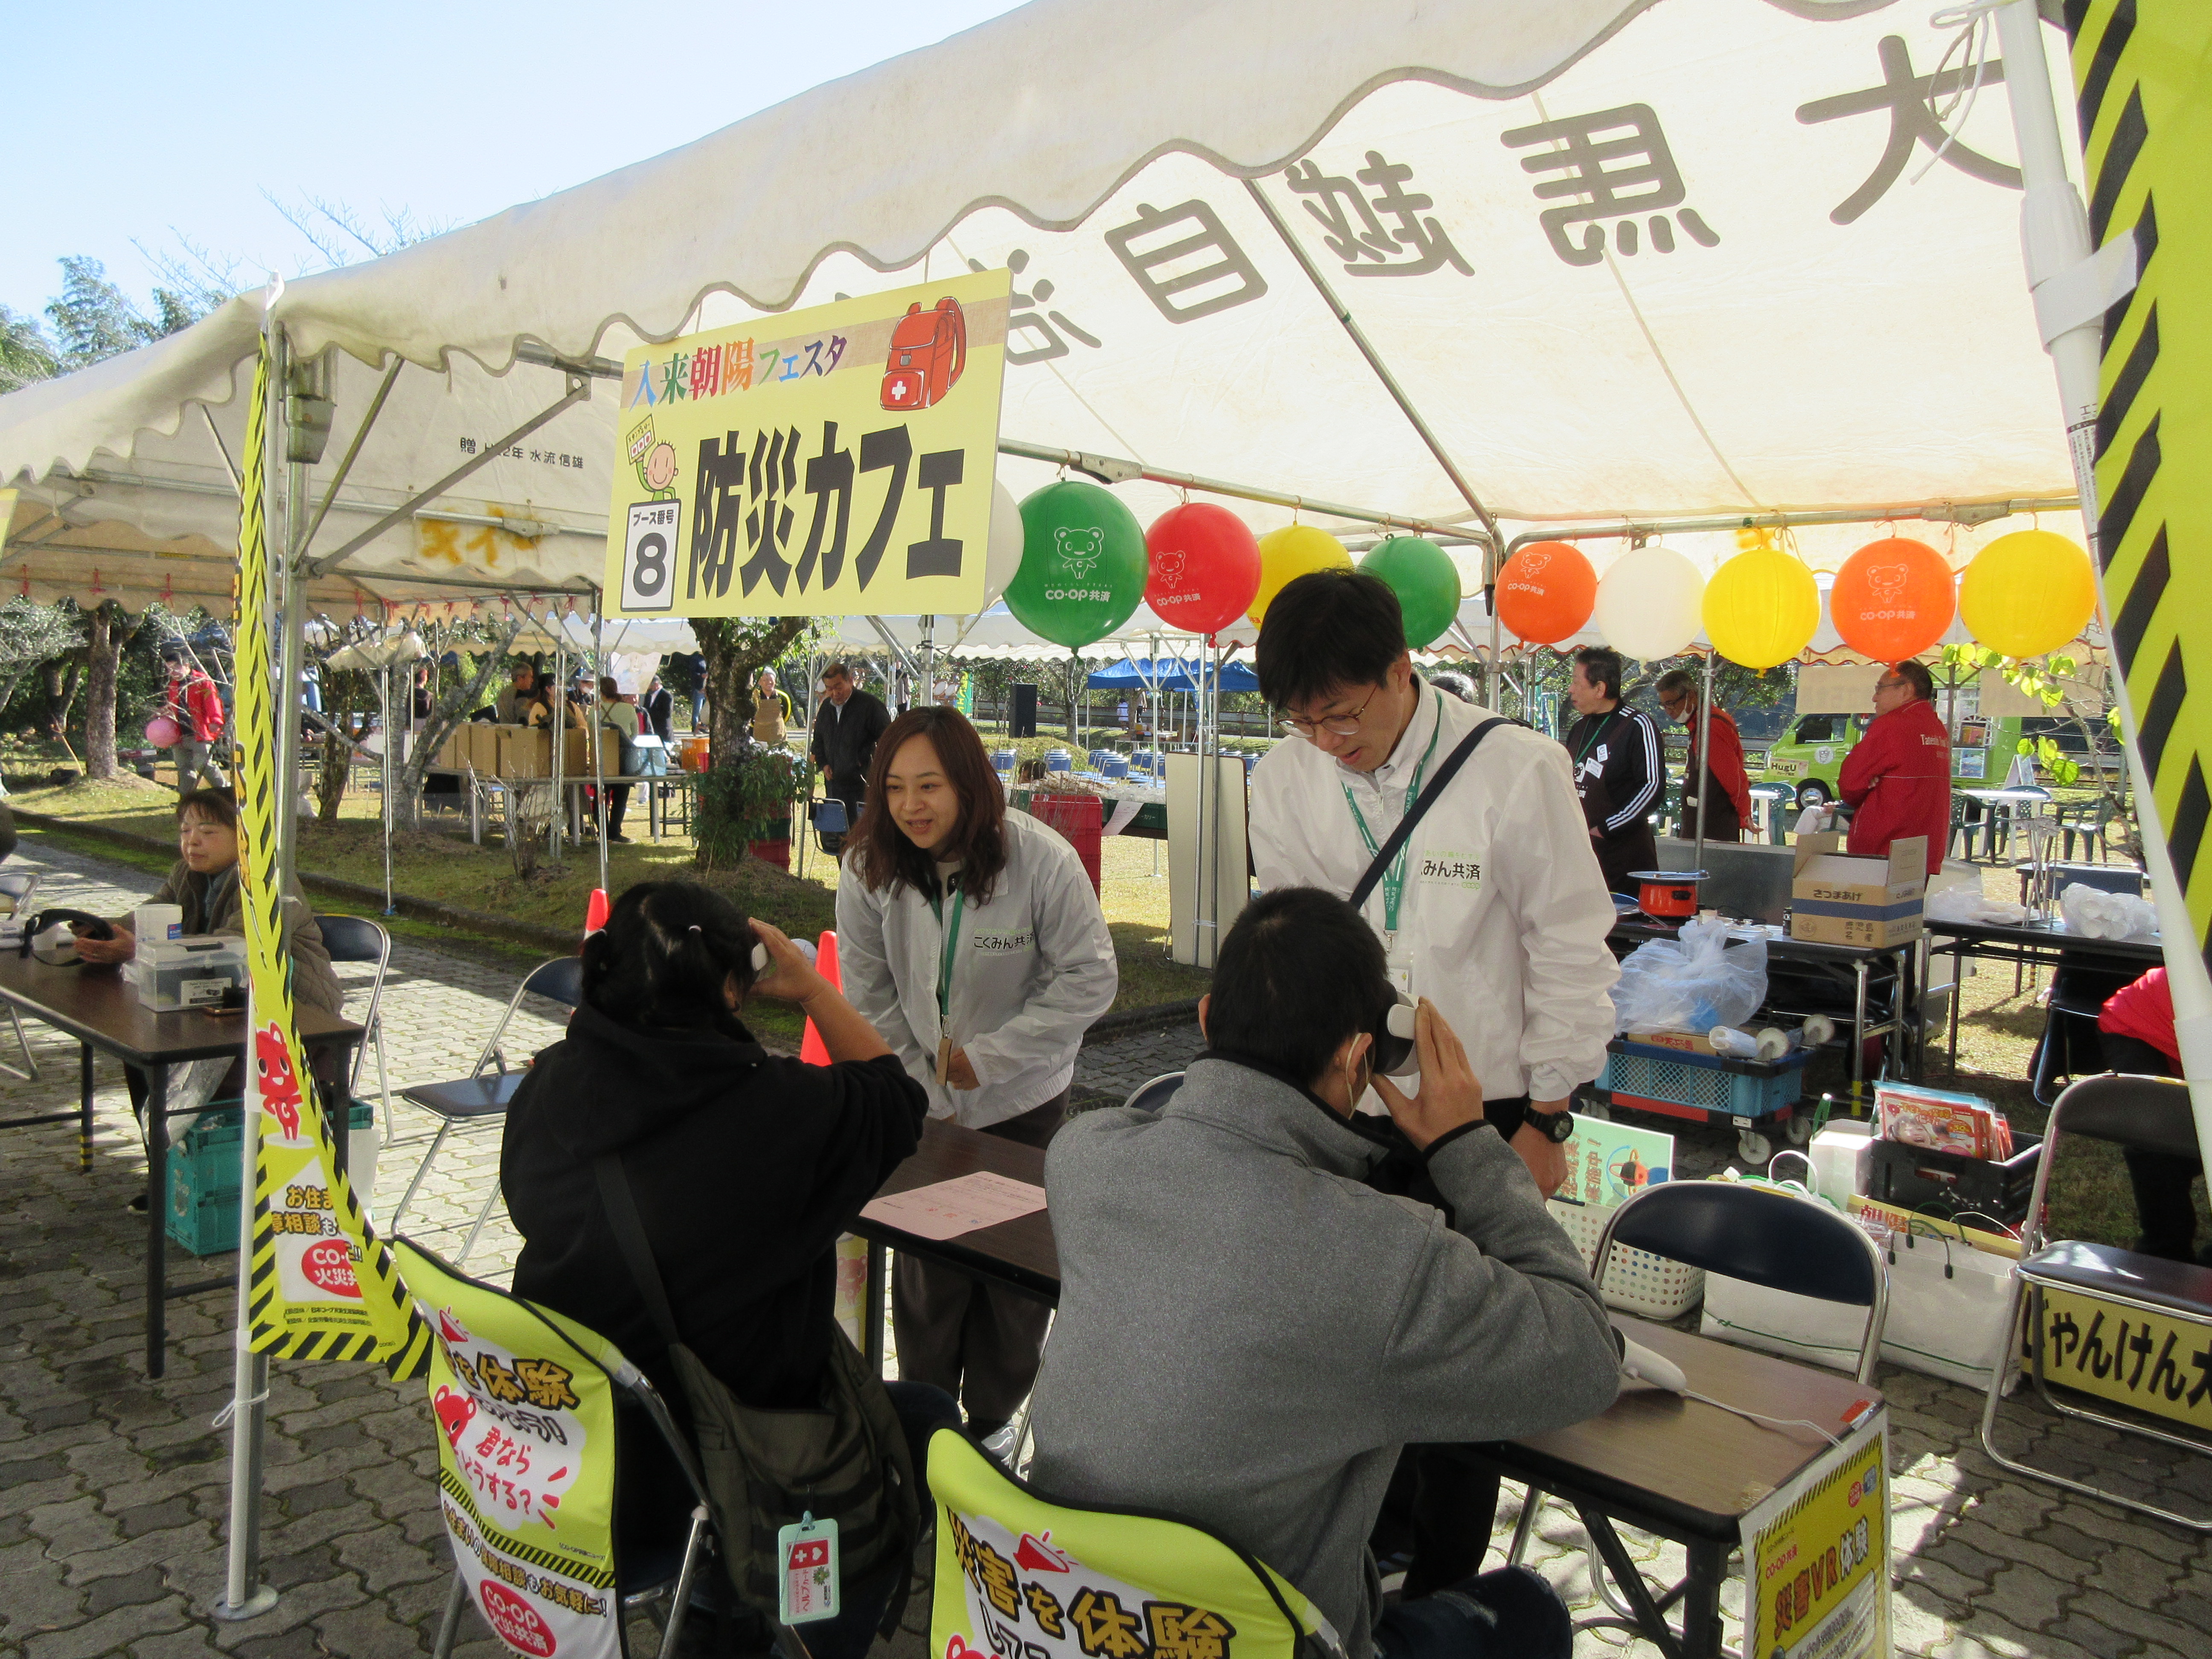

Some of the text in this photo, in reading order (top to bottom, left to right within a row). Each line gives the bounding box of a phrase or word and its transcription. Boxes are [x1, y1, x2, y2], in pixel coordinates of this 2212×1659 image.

[628, 334, 848, 413] 入来朝陽フェスタ
[460, 437, 477, 454] 贈
[632, 508, 675, 527] ブース番号
[687, 420, 965, 600] 防災カフェ
[633, 532, 668, 597] 8
[1771, 763, 1796, 772] HugU
[1421, 860, 1481, 881] みん共済
[1813, 889, 1863, 901] さつまあげ
[476, 1425, 531, 1475] 君なら
